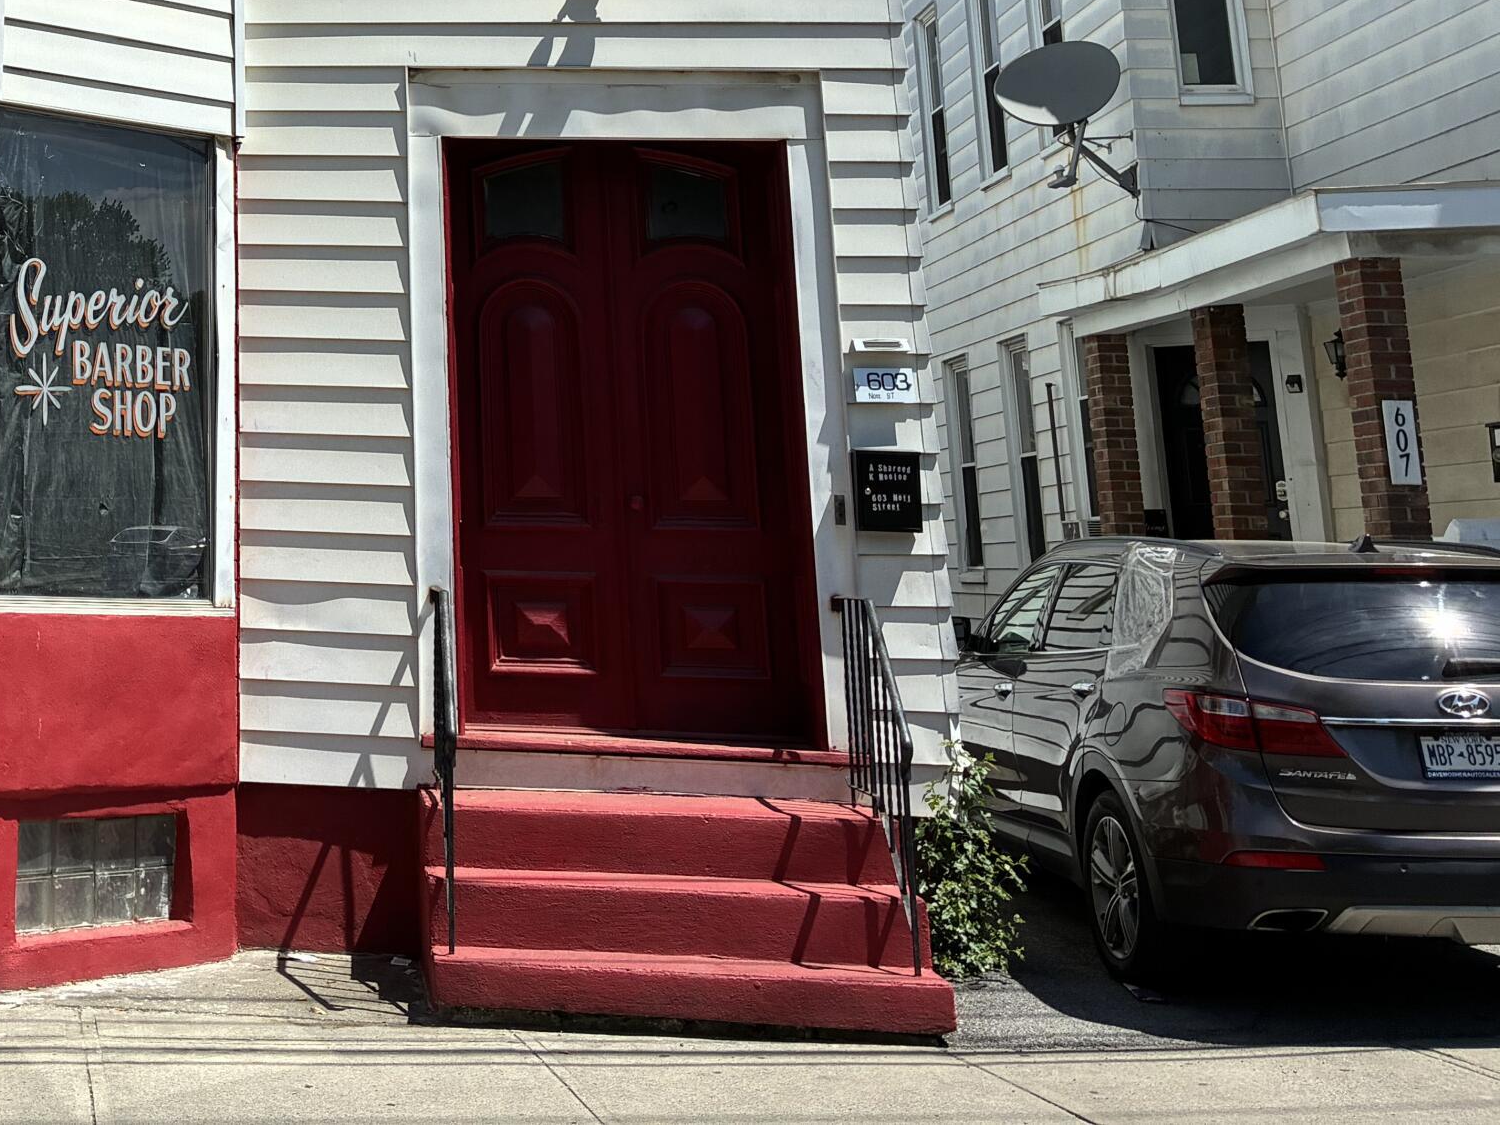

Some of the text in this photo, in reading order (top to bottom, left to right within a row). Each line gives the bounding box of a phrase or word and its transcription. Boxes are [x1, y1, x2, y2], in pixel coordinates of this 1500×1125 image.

[9, 257, 189, 358] Superior
[72, 339, 192, 391] BARBER
[866, 372, 909, 391] 603
[90, 387, 177, 439] SHOP
[1394, 407, 1410, 477] 607
[871, 493, 887, 502] 603
[1427, 744, 1454, 766] MBP
